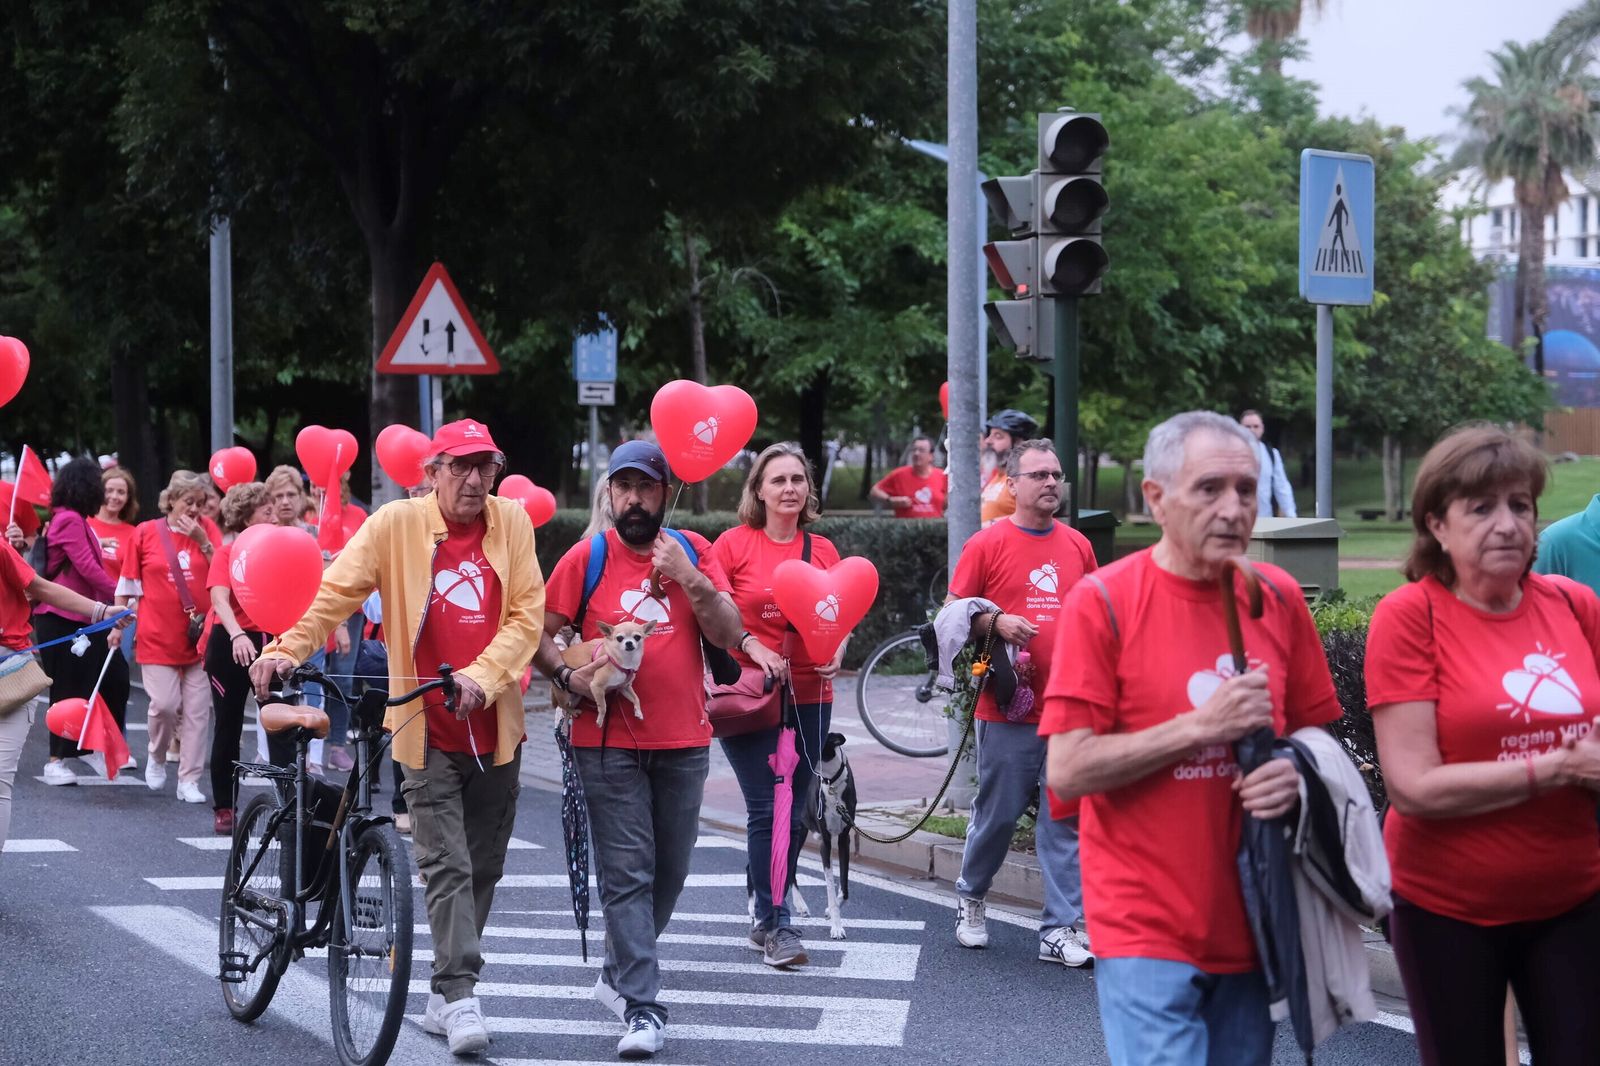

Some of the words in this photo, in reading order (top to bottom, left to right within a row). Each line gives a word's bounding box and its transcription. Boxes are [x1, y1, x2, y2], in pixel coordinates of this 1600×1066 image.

[762, 610, 781, 619] dona
[1501, 729, 1556, 749] regala
[1559, 722, 1591, 744] VID
[1173, 763, 1214, 780] dona
